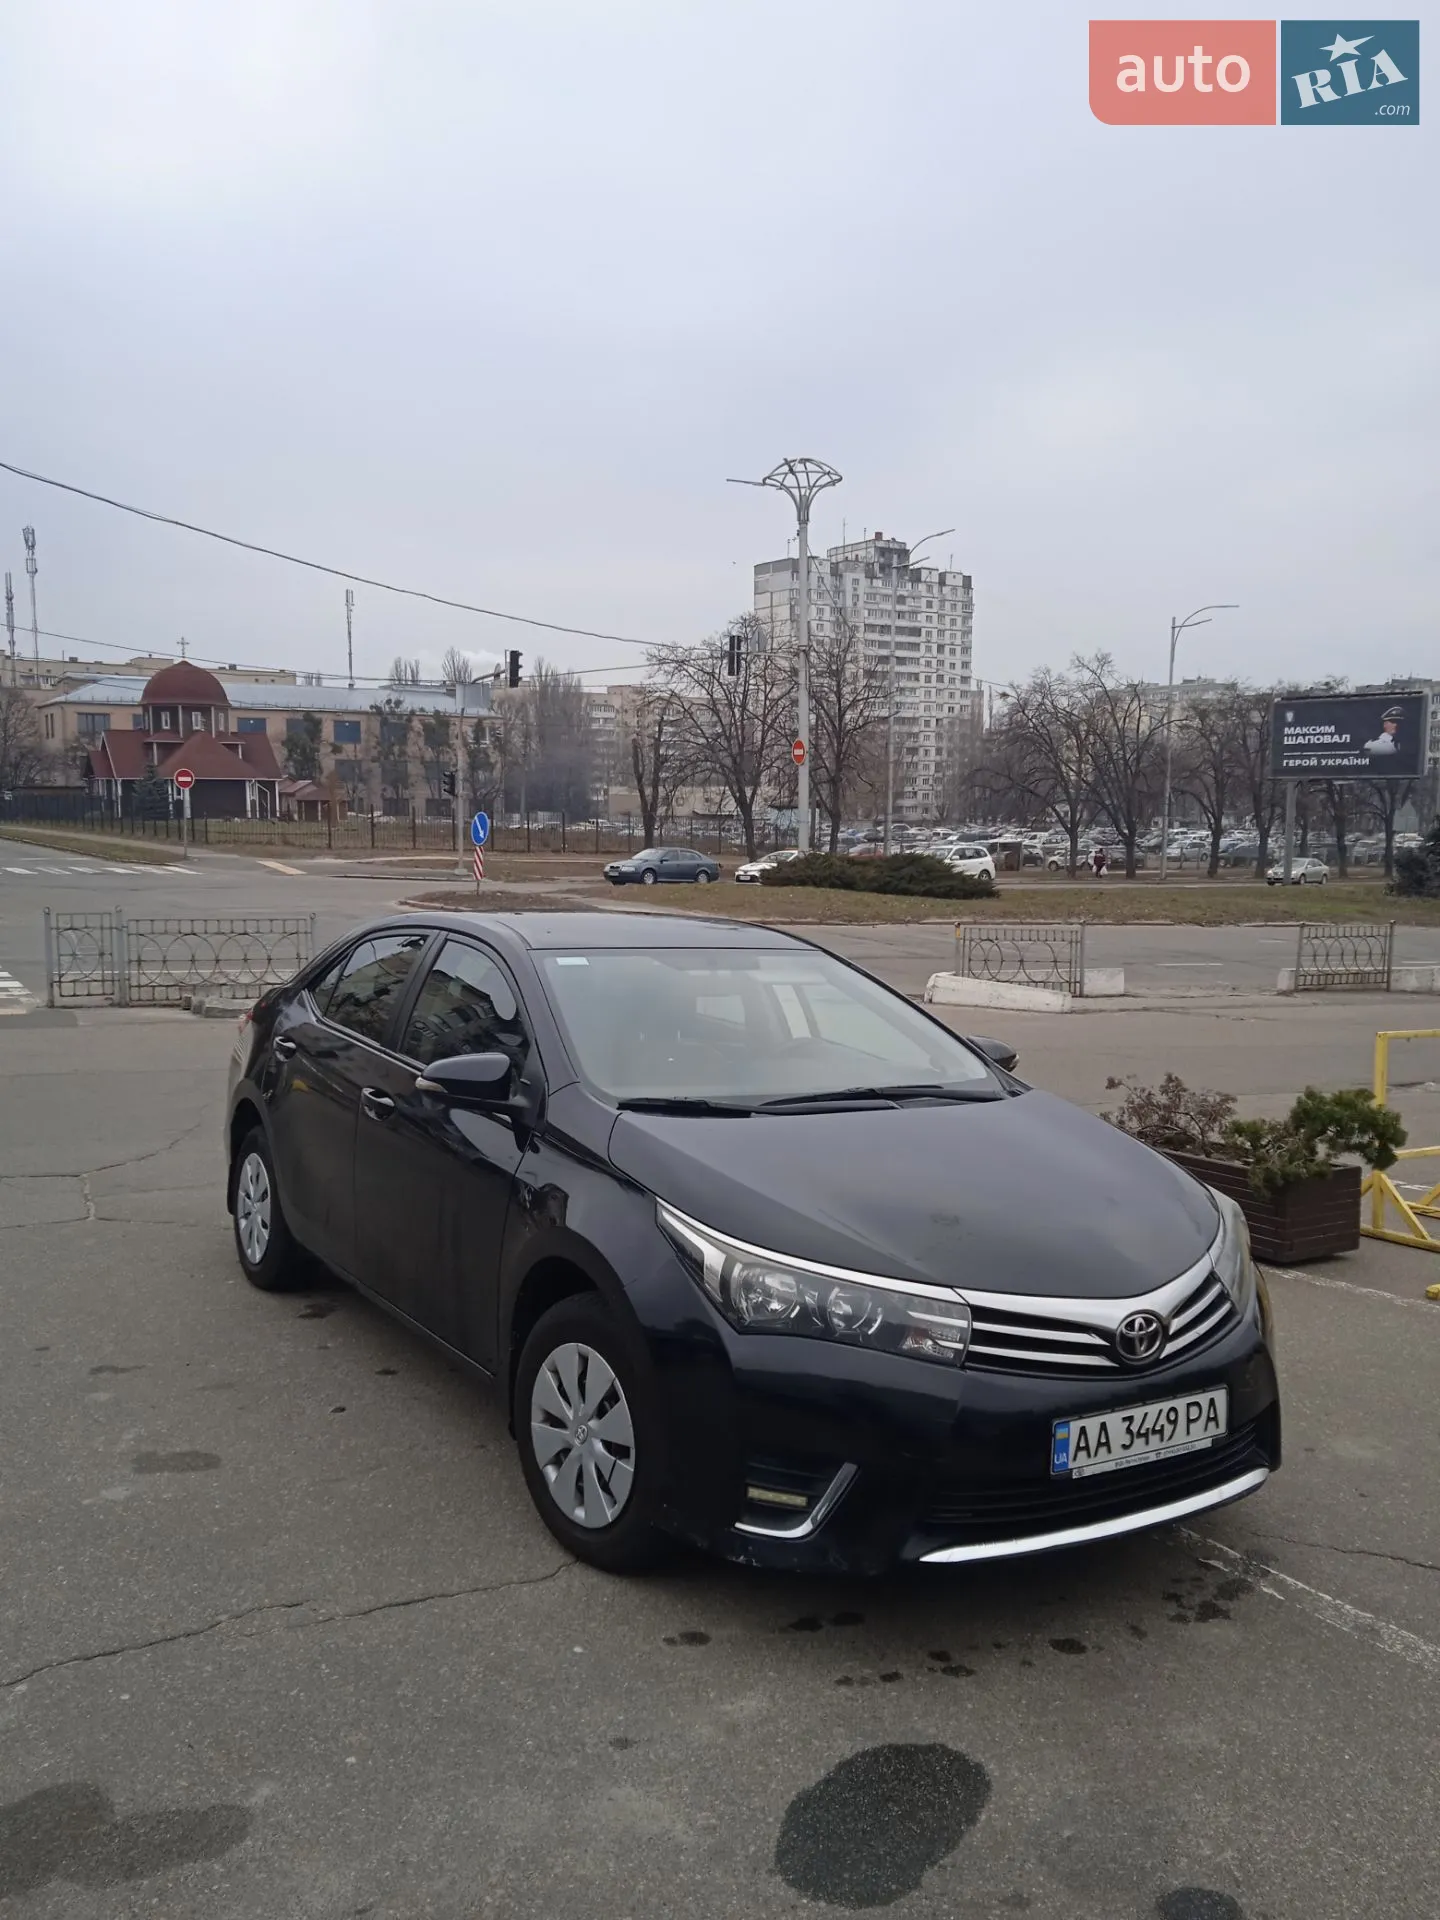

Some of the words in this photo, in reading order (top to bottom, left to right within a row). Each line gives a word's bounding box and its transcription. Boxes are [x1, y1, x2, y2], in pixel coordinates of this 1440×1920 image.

[1284, 725, 1335, 735] МАКСИМ
[1283, 734, 1350, 745] ШАПОВАЛ
[1283, 757, 1318, 767] ГЕРОЙ
[1320, 756, 1370, 766] УКРАЇНИ
[1072, 1421, 1112, 1462] AA
[1121, 1406, 1179, 1450] 3449
[1186, 1397, 1220, 1436] PA
[1054, 1453, 1068, 1465] UA
